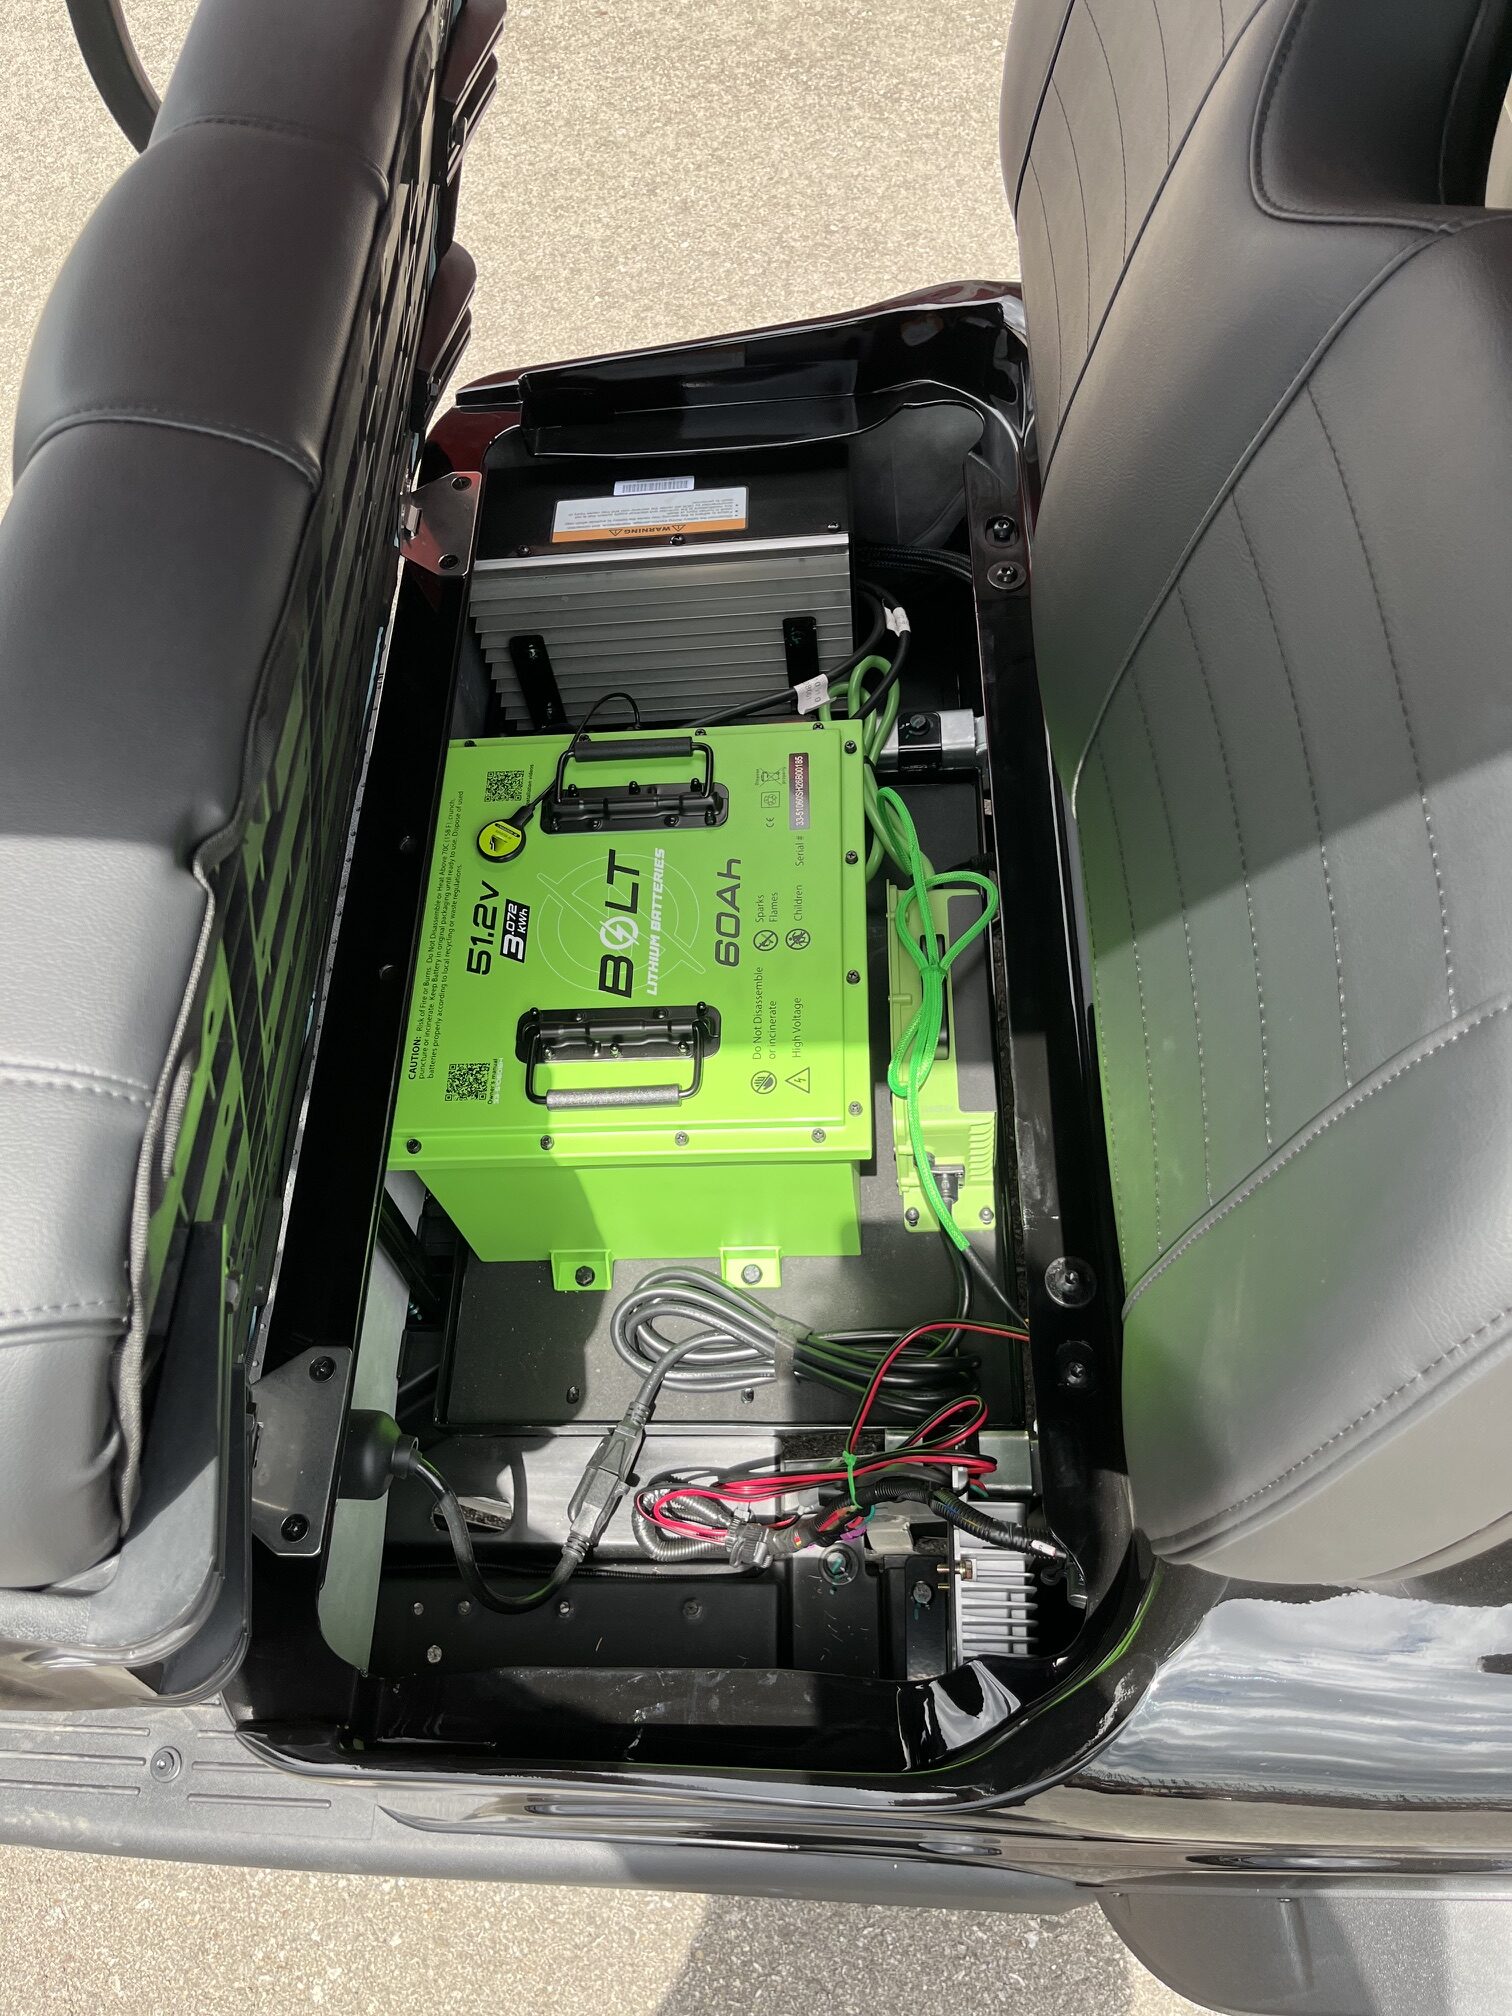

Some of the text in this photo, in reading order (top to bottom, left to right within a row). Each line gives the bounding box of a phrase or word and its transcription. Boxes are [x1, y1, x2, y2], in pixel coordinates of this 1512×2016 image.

[624, 526, 671, 534] WARNING
[452, 813, 462, 836] Dispose
[766, 817, 774, 828] CE
[439, 857, 447, 875] Above
[447, 858, 456, 875] ready
[795, 843, 804, 866] Serial
[437, 877, 445, 891] Heat
[444, 877, 452, 891] until
[441, 892, 451, 924] packaging
[449, 900, 457, 919] waste
[715, 859, 741, 967] 60Ah
[755, 895, 765, 923] Sparks
[770, 892, 778, 923] Flames
[794, 885, 803, 921] Children
[430, 900, 441, 938] Disassemble
[517, 908, 528, 933] kWh
[598, 849, 640, 998] BOLT
[647, 848, 665, 995] LITHIUM BATTERIES
[428, 940, 436, 952] Not
[436, 926, 446, 950] original
[444, 929, 455, 957] recycling
[426, 954, 433, 963] Do
[432, 959, 442, 982] Battery
[441, 959, 449, 974] local
[419, 996, 428, 1008] Fire
[429, 984, 438, 1000] Keep
[436, 984, 447, 1016] according
[416, 1018, 425, 1031] Risk
[753, 967, 763, 1060] Do Not Disassemble
[432, 1018, 443, 1046] properly
[768, 1001, 777, 1059] or incinerate
[792, 998, 802, 1058] High Voltage
[408, 1037, 422, 1080] CAUTION:
[419, 1047, 429, 1079] puncture
[427, 1048, 438, 1078] batteries
